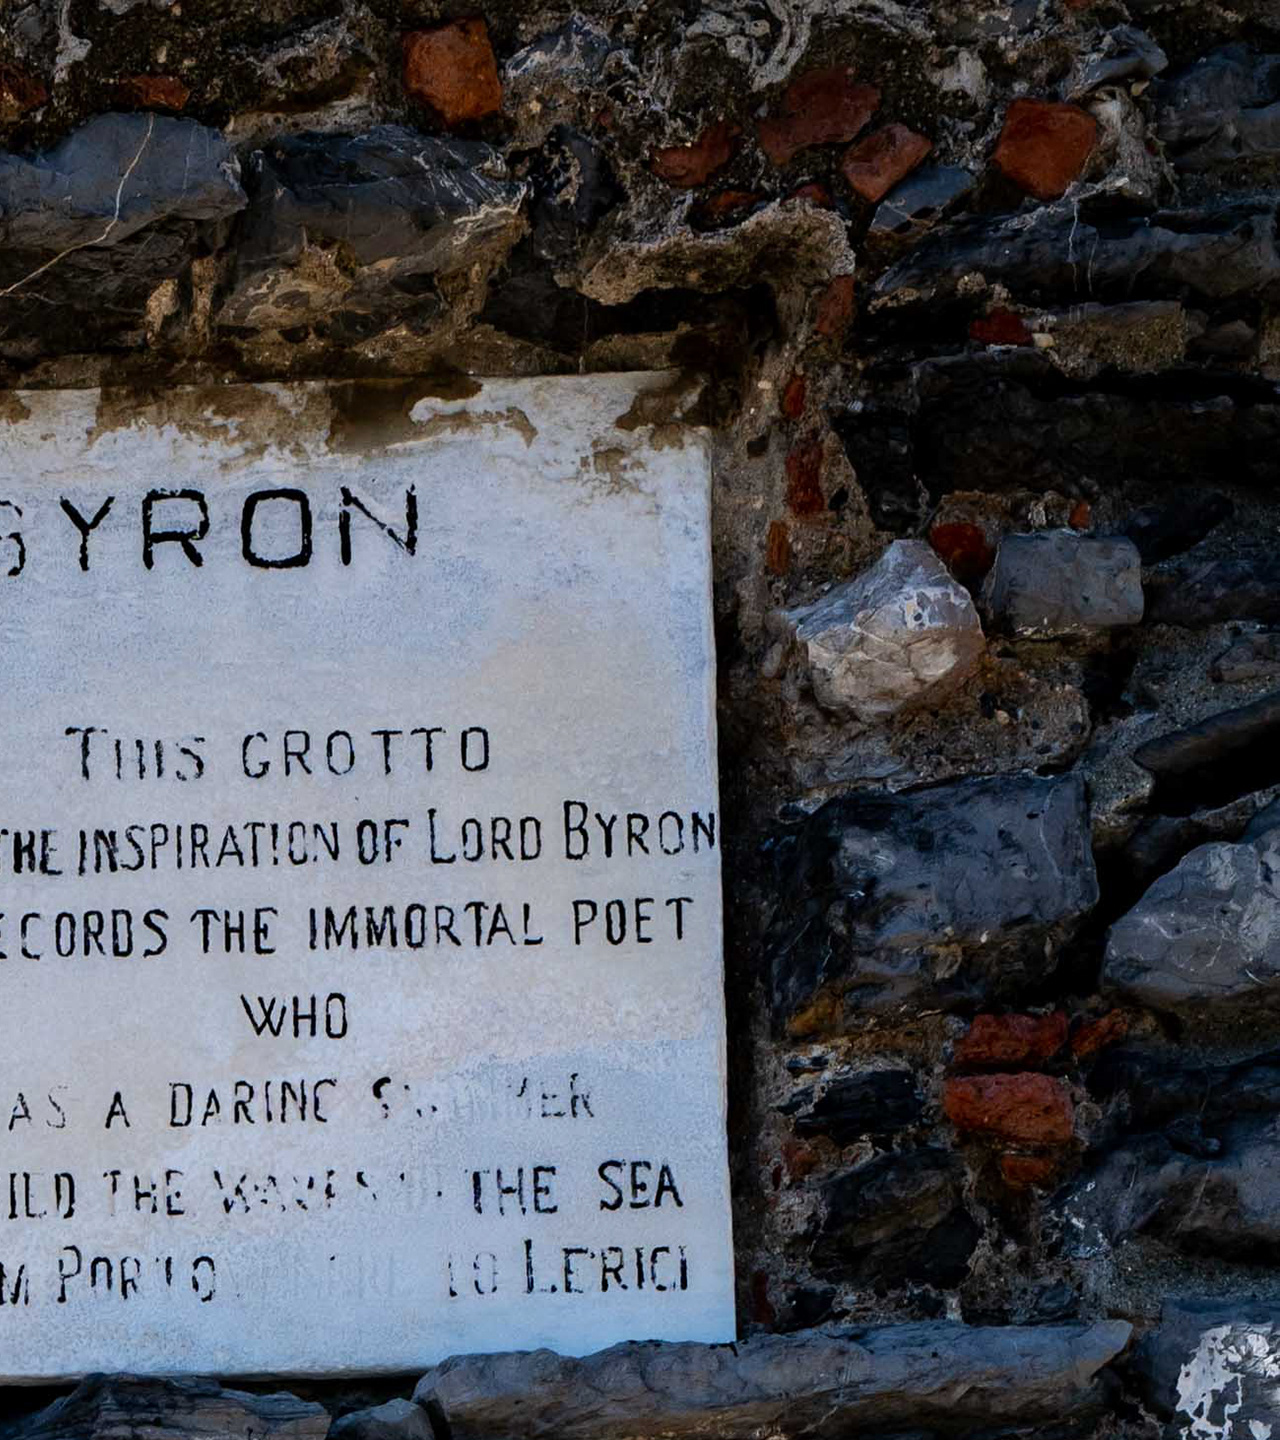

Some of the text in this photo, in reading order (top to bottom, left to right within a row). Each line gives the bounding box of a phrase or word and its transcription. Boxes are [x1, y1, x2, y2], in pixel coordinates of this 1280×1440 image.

[241, 726, 490, 780] GROTTO
[77, 820, 340, 877] INSPIRATION
[355, 818, 410, 866] OF
[426, 807, 542, 865] LORD
[563, 799, 715, 861] BYRON
[189, 906, 279, 956] THE
[309, 900, 544, 952] IMMORTAL
[571, 896, 694, 946] POET
[239, 992, 349, 1040] WHO
[8, 1084, 69, 1132] AS
[104, 1090, 131, 1130] A
[102, 1168, 186, 1217] THE
[464, 1165, 559, 1217] THE
[597, 1158, 684, 1212] SEA
